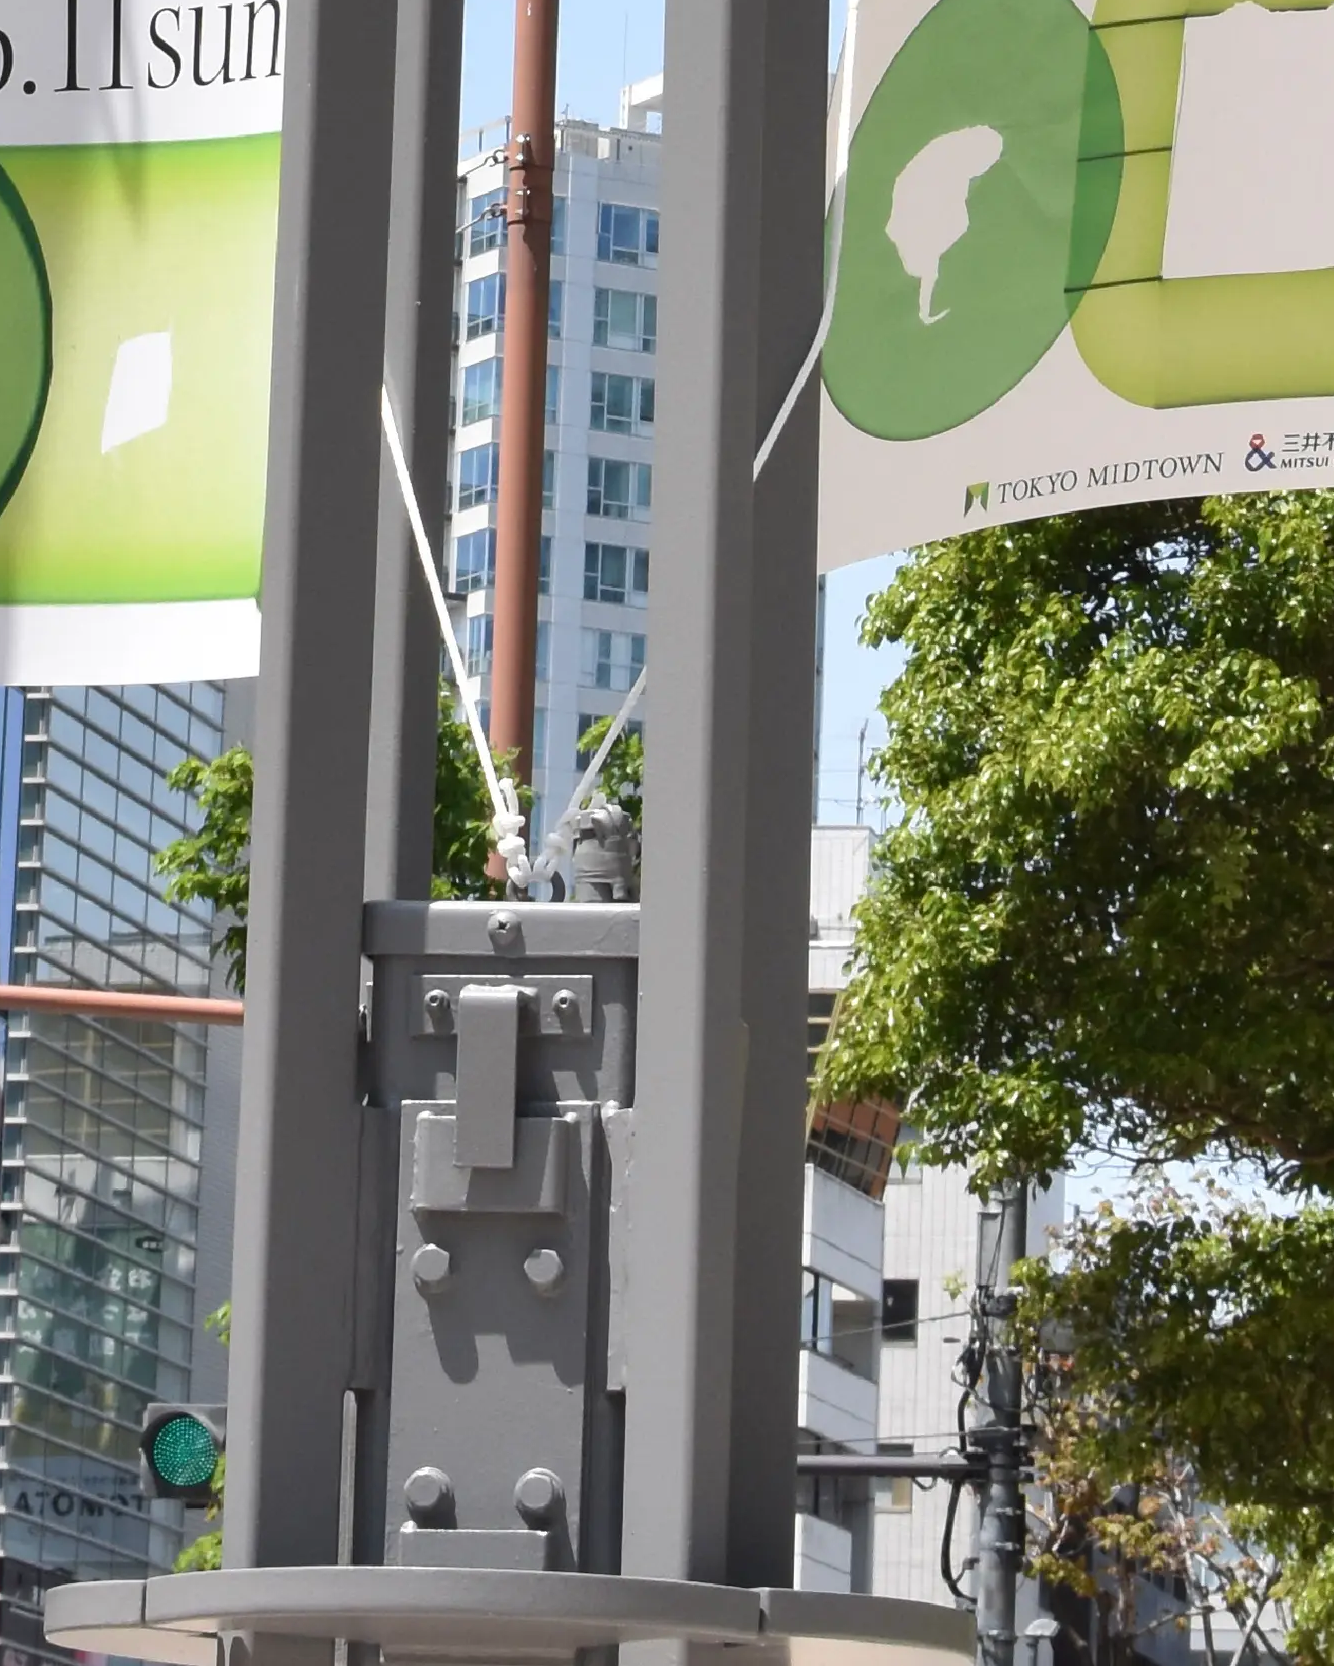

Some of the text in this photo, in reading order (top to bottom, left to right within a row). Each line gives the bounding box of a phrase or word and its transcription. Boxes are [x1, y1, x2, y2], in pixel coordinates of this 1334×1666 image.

[997, 452, 1224, 504] TOKYO MIDTOWN
[1280, 456, 1329, 469] MITSUI
